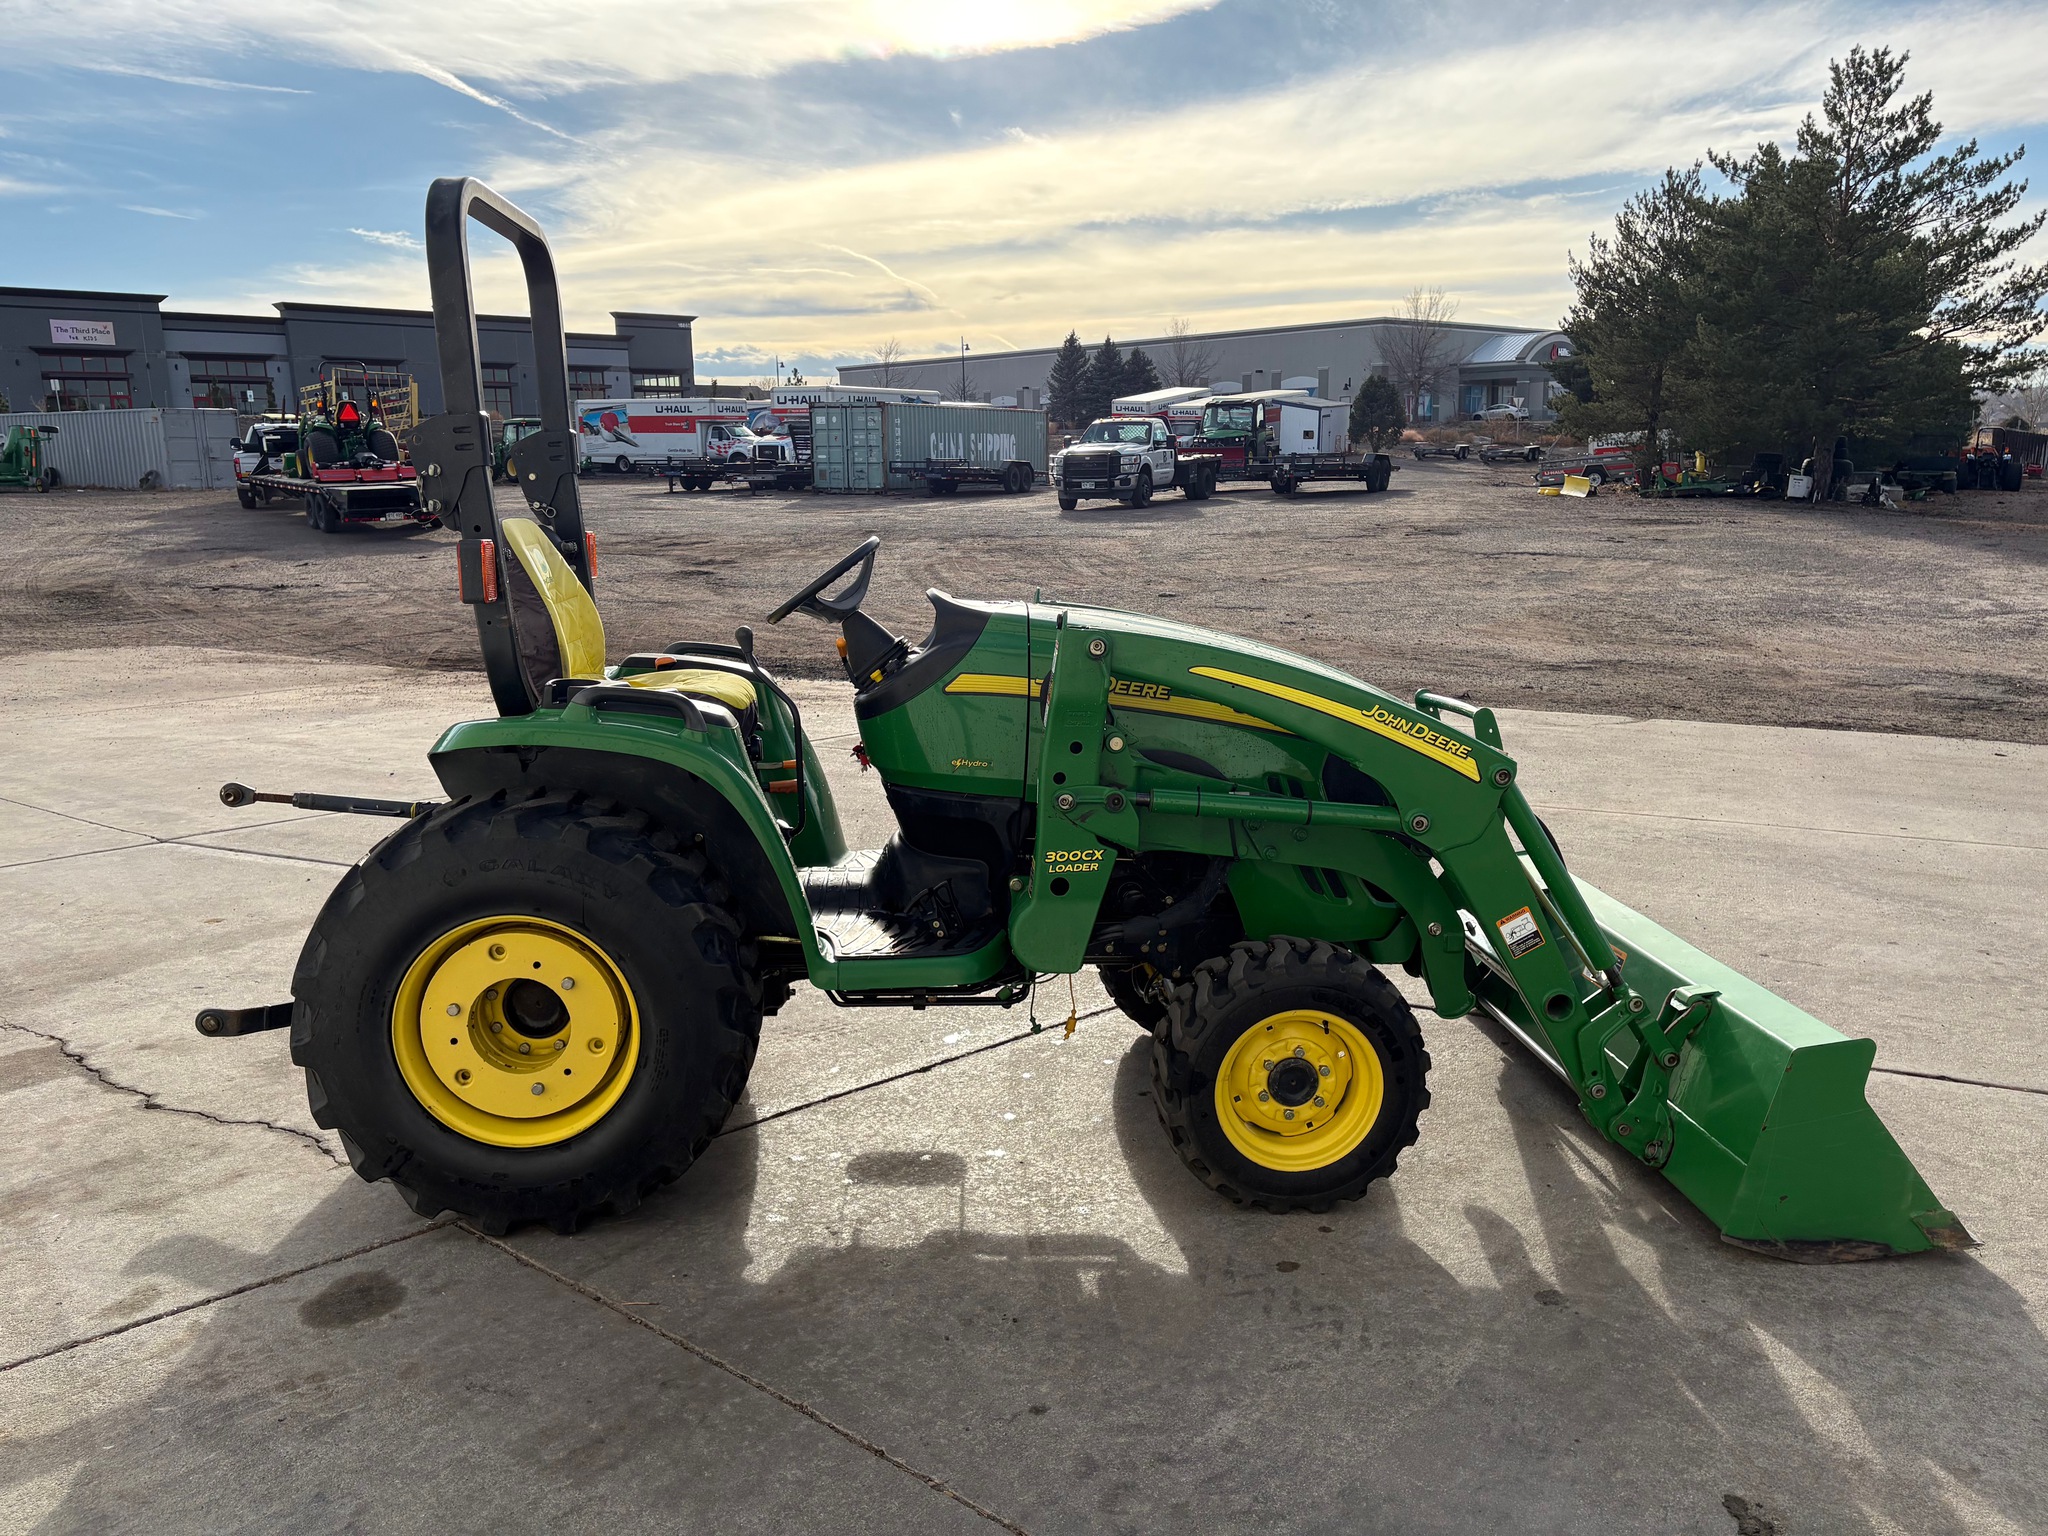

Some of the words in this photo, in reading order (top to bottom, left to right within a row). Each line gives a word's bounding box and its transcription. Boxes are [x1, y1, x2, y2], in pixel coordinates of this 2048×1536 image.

[655, 405, 693, 414] U-HAUL
[717, 405, 746, 414] U-HAUL
[1116, 405, 1145, 413] U-HAUL
[930, 432, 963, 460] CHINA
[970, 432, 1016, 461] SHIPPING
[1361, 704, 1413, 733] JOHN
[1410, 722, 1473, 759] DEERE
[1045, 849, 1105, 863] 300CX
[1048, 863, 1099, 873] LOADER
[478, 858, 622, 900] GALAXY
